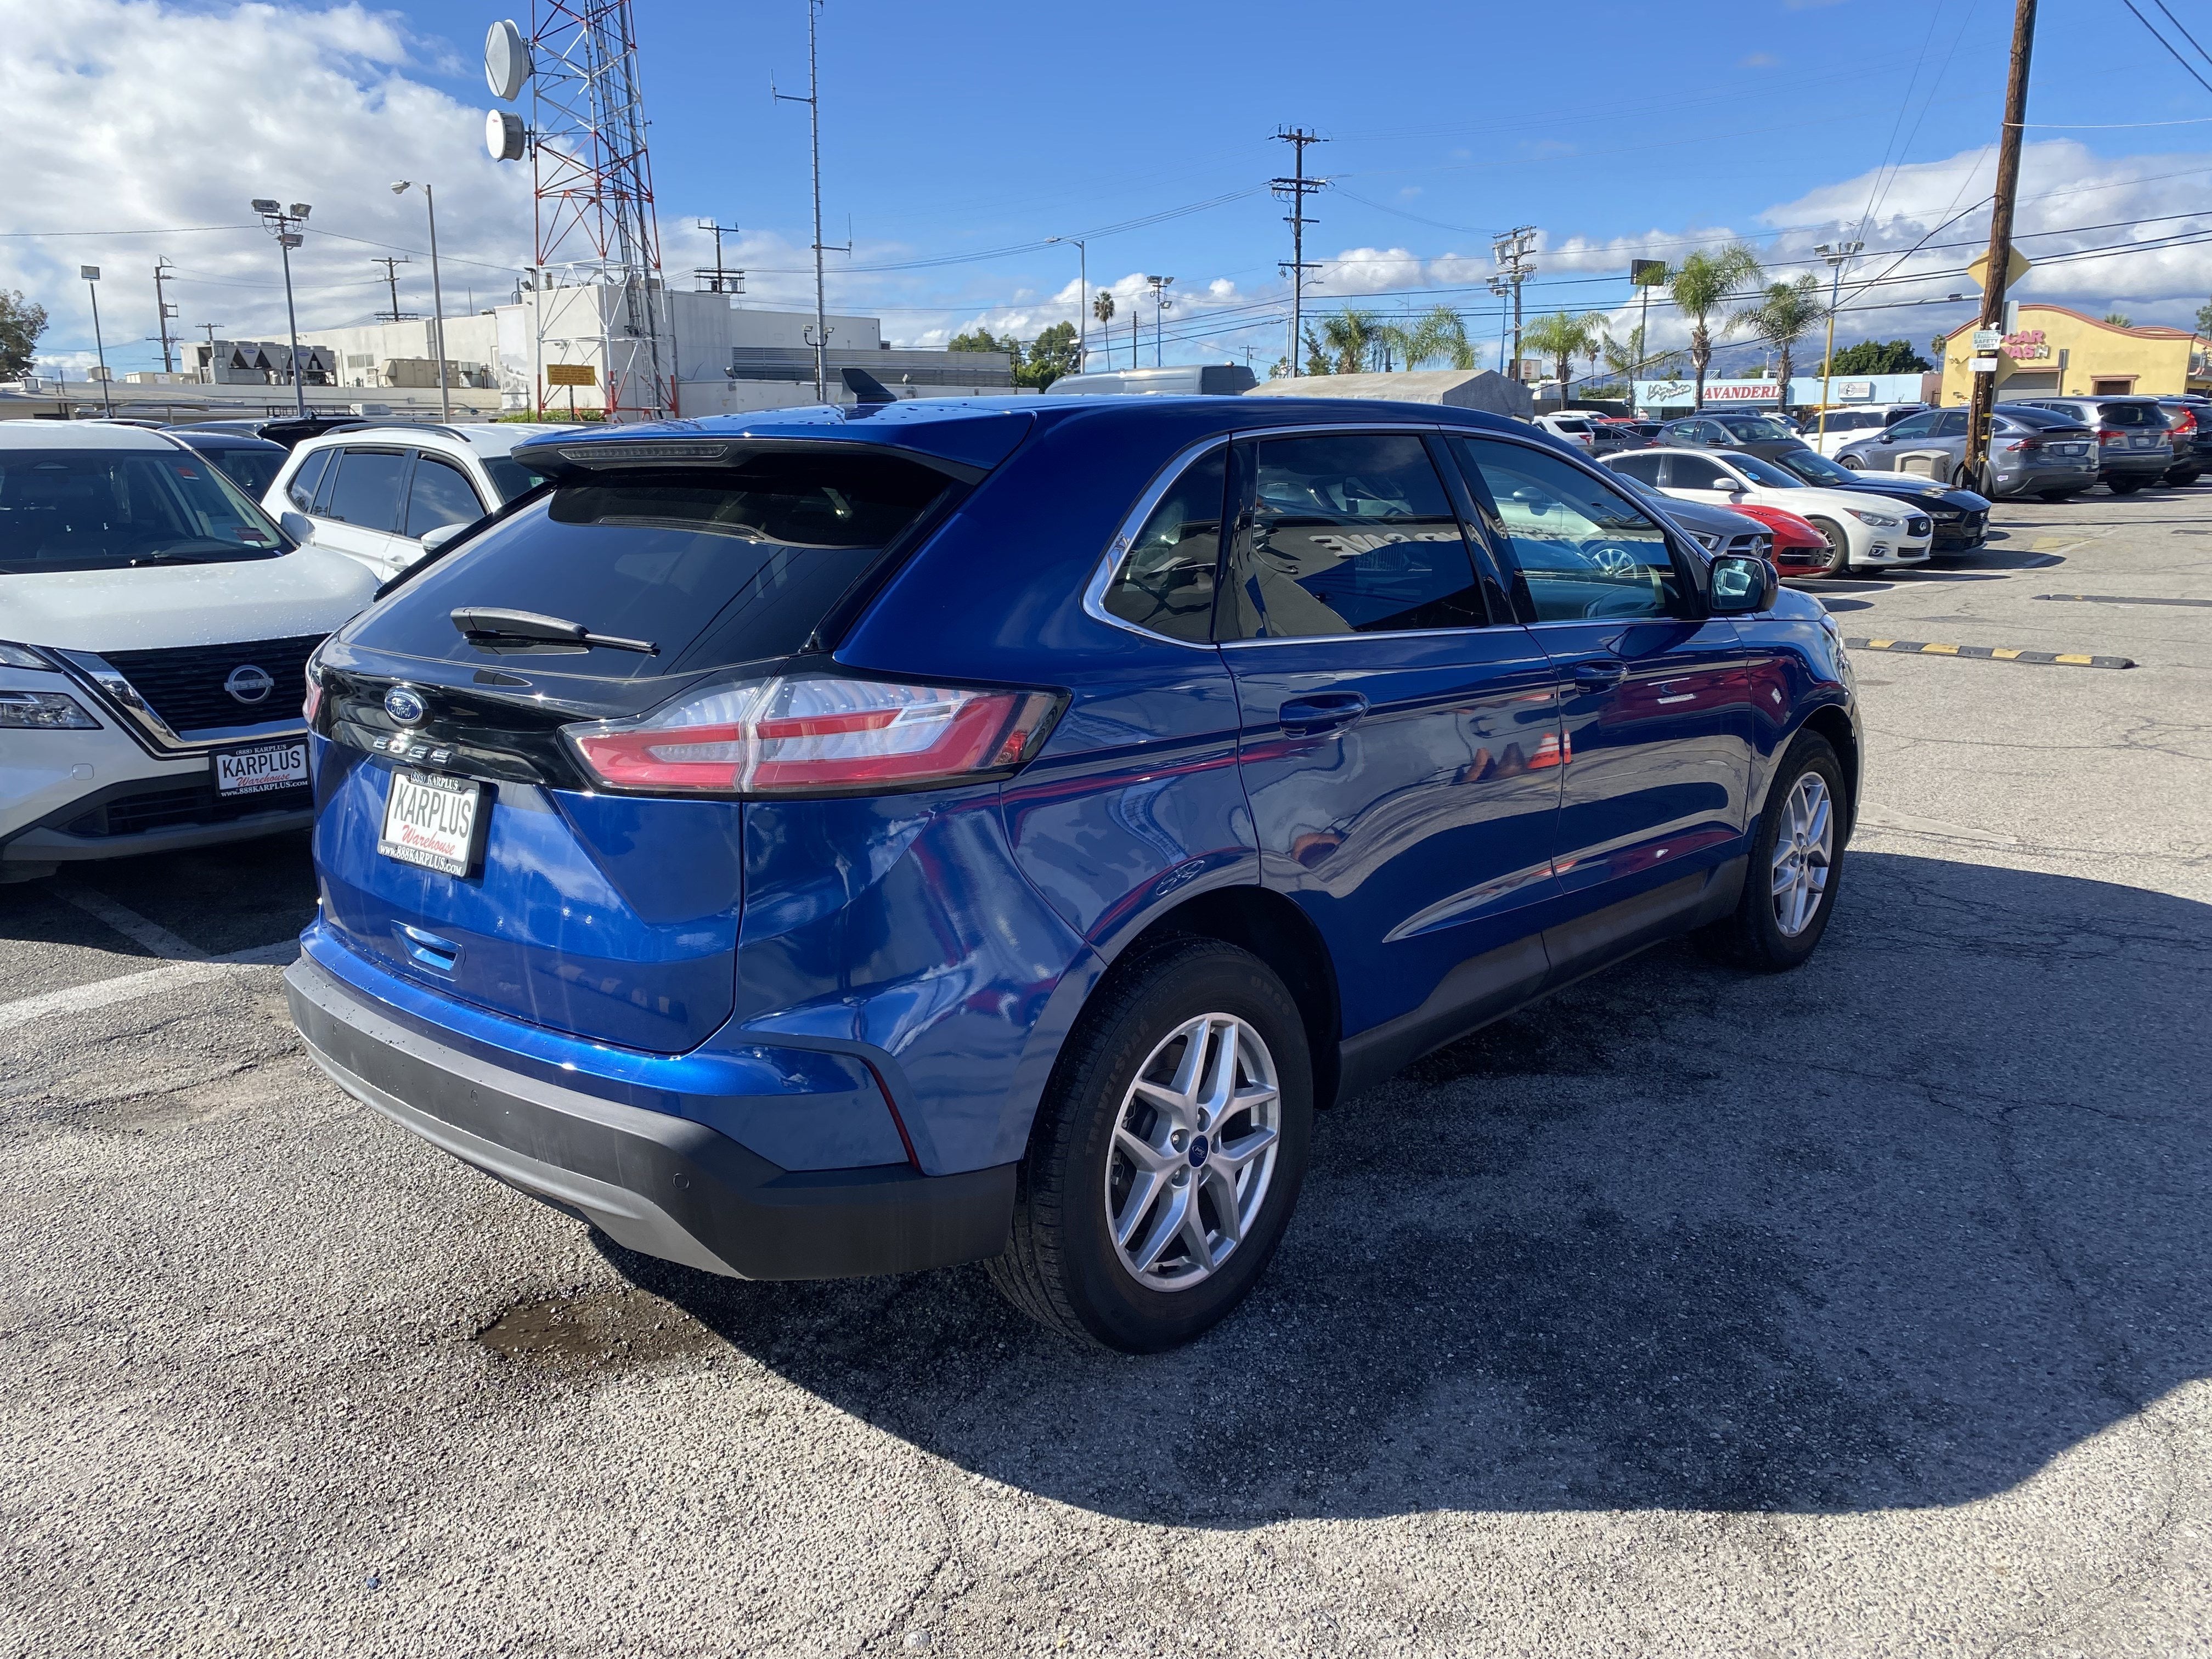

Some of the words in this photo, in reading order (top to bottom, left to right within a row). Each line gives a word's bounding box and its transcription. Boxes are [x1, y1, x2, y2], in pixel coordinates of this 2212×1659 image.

[2004, 330, 2044, 344] CAR
[1695, 386, 1780, 399] AVANDERI
[225, 679, 272, 689] NISSAN
[255, 744, 287, 754] KARPLUS
[373, 736, 452, 764] EDGE
[222, 751, 301, 778] KARPLUS
[236, 772, 290, 787] Warehouse
[427, 775, 459, 791] KARPLUS
[393, 783, 471, 838] KARPLUS
[402, 824, 456, 856] Warehouse
[1085, 1019, 1150, 1155] TRAVELSTAR
